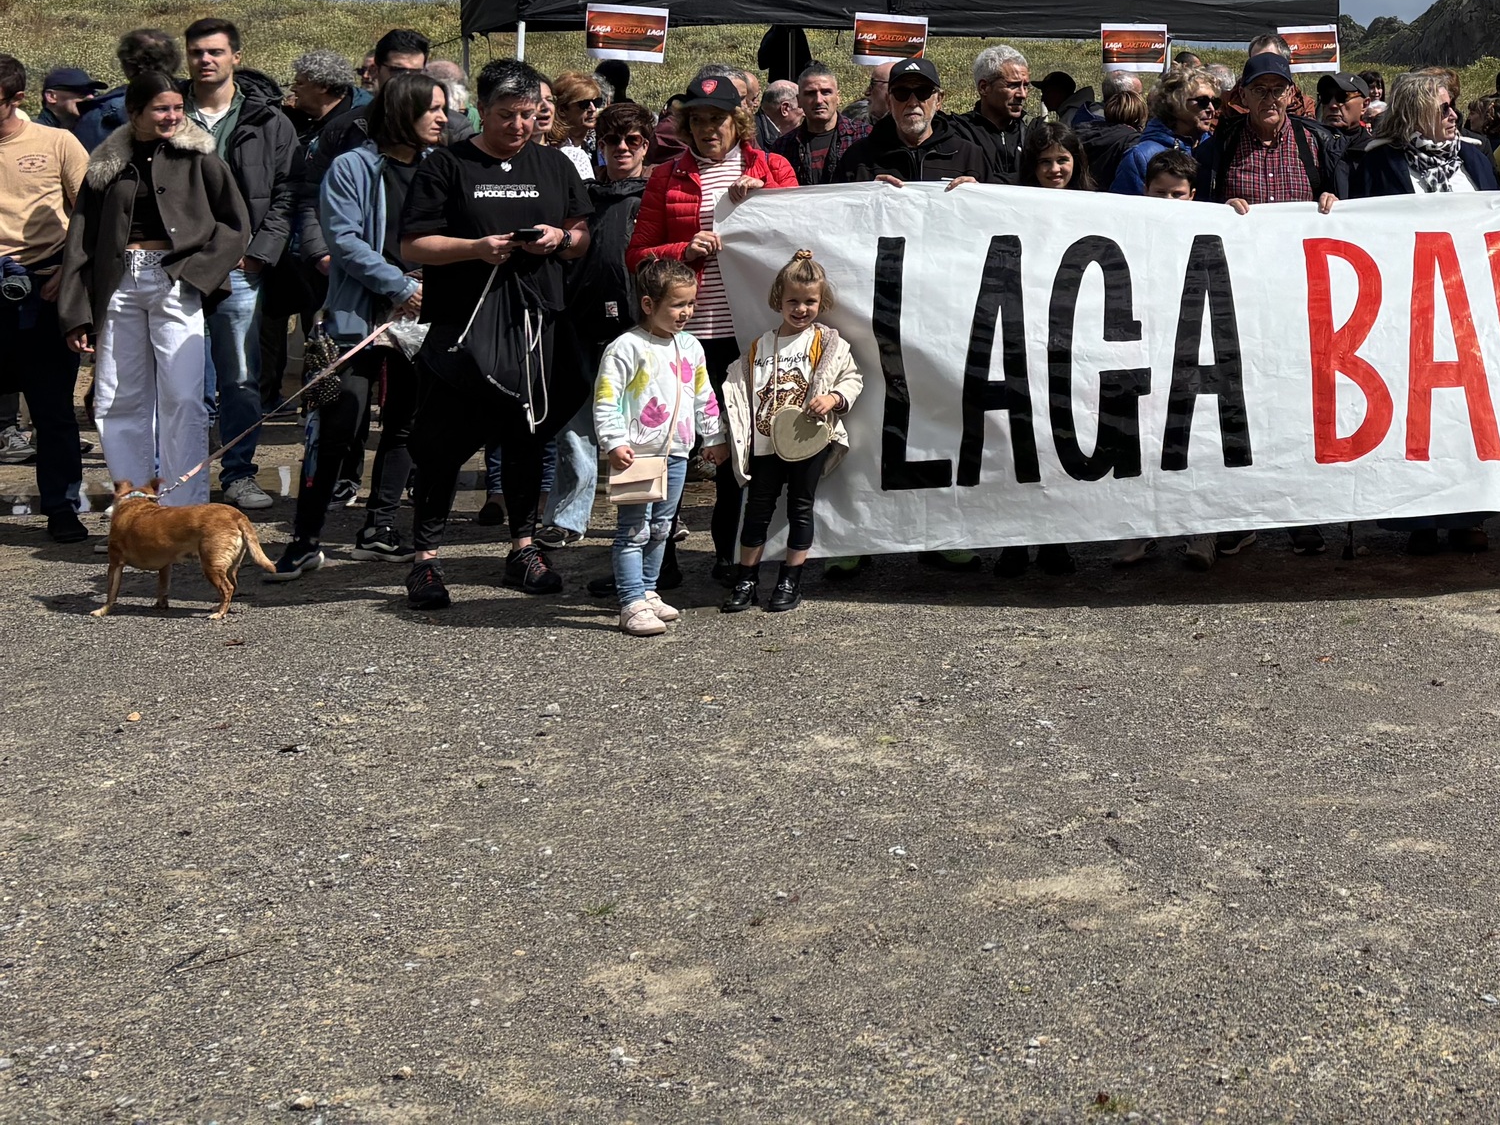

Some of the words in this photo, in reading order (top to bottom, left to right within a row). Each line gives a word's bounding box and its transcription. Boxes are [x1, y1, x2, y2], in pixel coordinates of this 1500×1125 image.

[588, 24, 612, 33] LAGA
[612, 25, 647, 34] BAKETAN
[647, 28, 665, 36] LAGA
[857, 32, 877, 40] LAGA
[474, 190, 506, 198] RHODE
[506, 190, 540, 198] ISLAND
[873, 234, 1253, 491] LAGA
